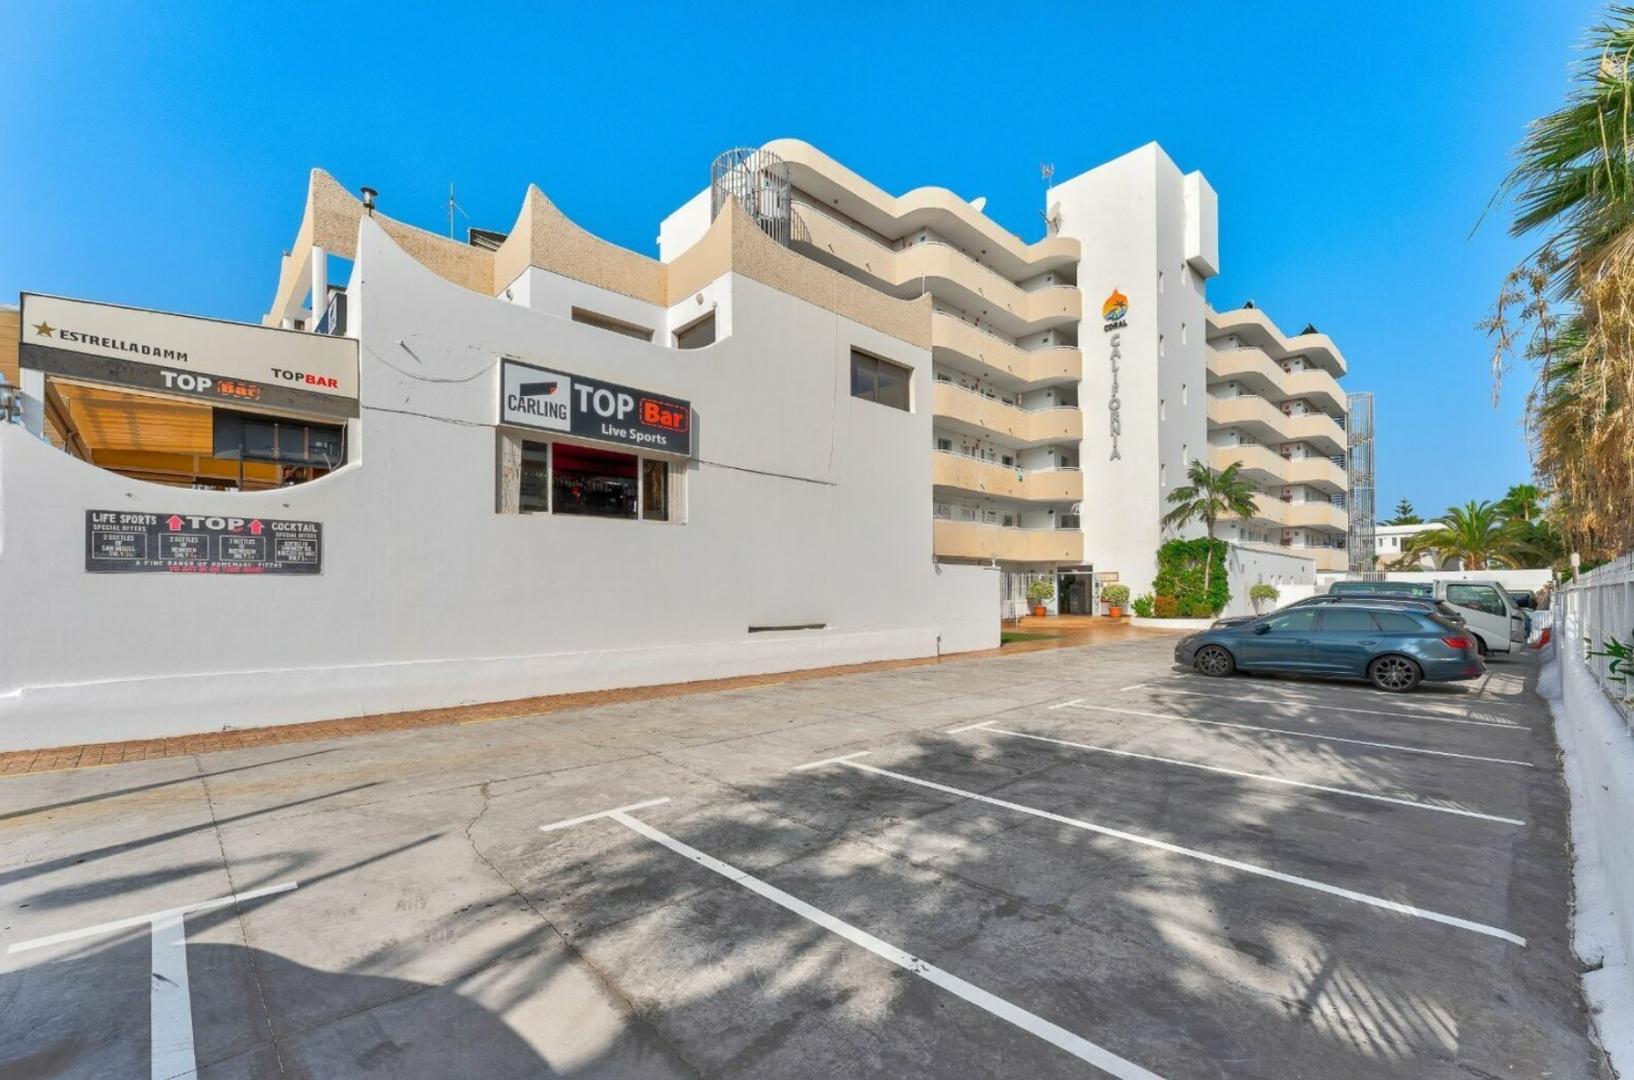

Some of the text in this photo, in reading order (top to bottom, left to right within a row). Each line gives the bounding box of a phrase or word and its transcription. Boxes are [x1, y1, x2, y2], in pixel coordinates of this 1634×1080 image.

[1104, 320, 1128, 333] CORAL
[160, 370, 255, 397] TOP Bar
[508, 394, 567, 420] CARLING
[574, 383, 683, 428] TOP Bar
[1108, 334, 1121, 461] CALIFORNIA
[601, 423, 667, 446] Live Sports
[92, 512, 157, 525] LIFE SPORTS
[186, 516, 244, 530] TOP
[271, 522, 318, 532] COCKTAIL
